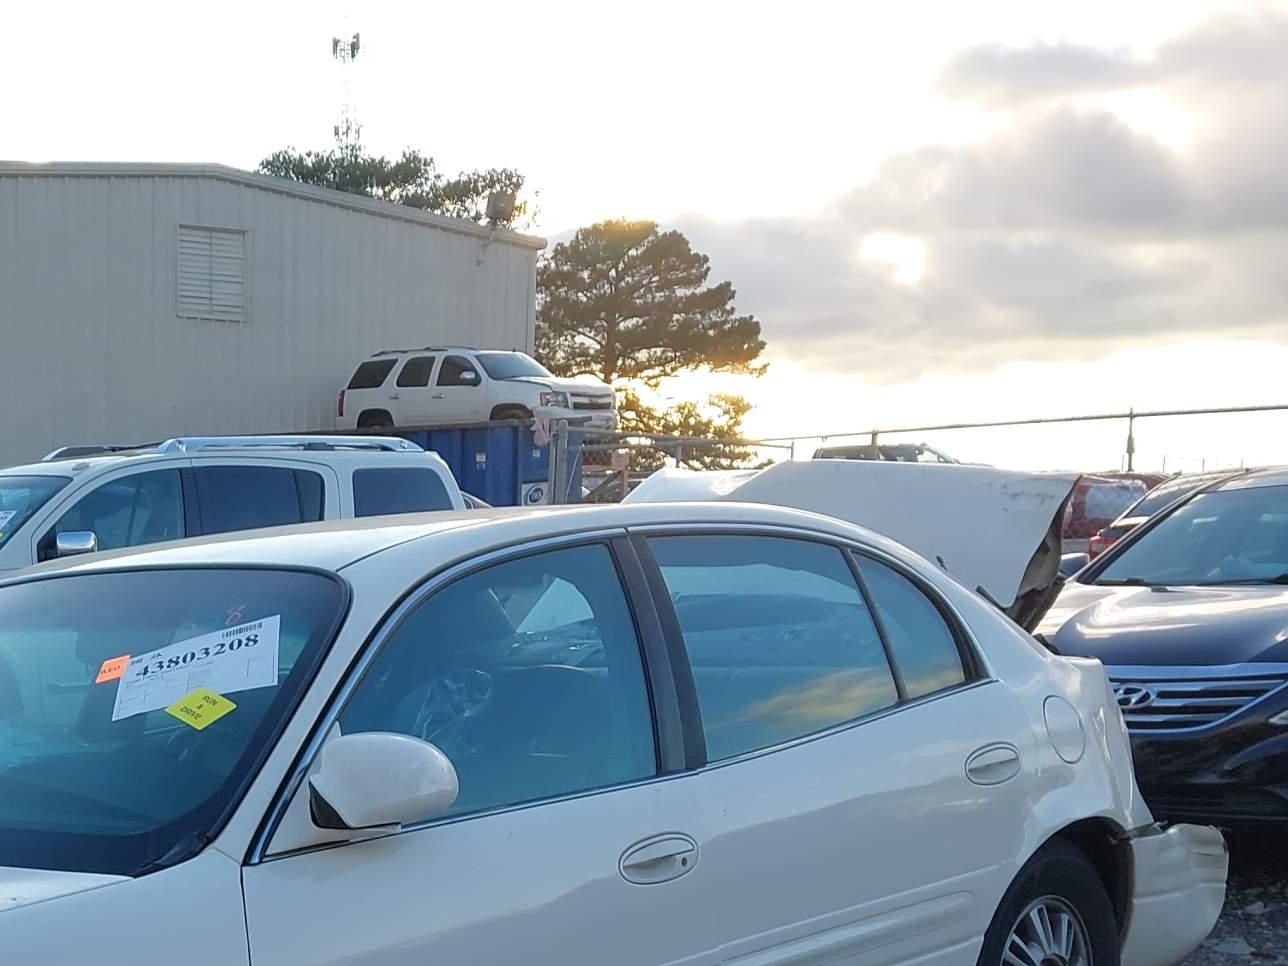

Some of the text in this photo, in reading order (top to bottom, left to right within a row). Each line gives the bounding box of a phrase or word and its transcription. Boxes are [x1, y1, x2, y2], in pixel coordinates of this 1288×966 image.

[136, 634, 259, 678] 43803208
[201, 695, 219, 706] RUN
[179, 706, 202, 720] DRIVE
